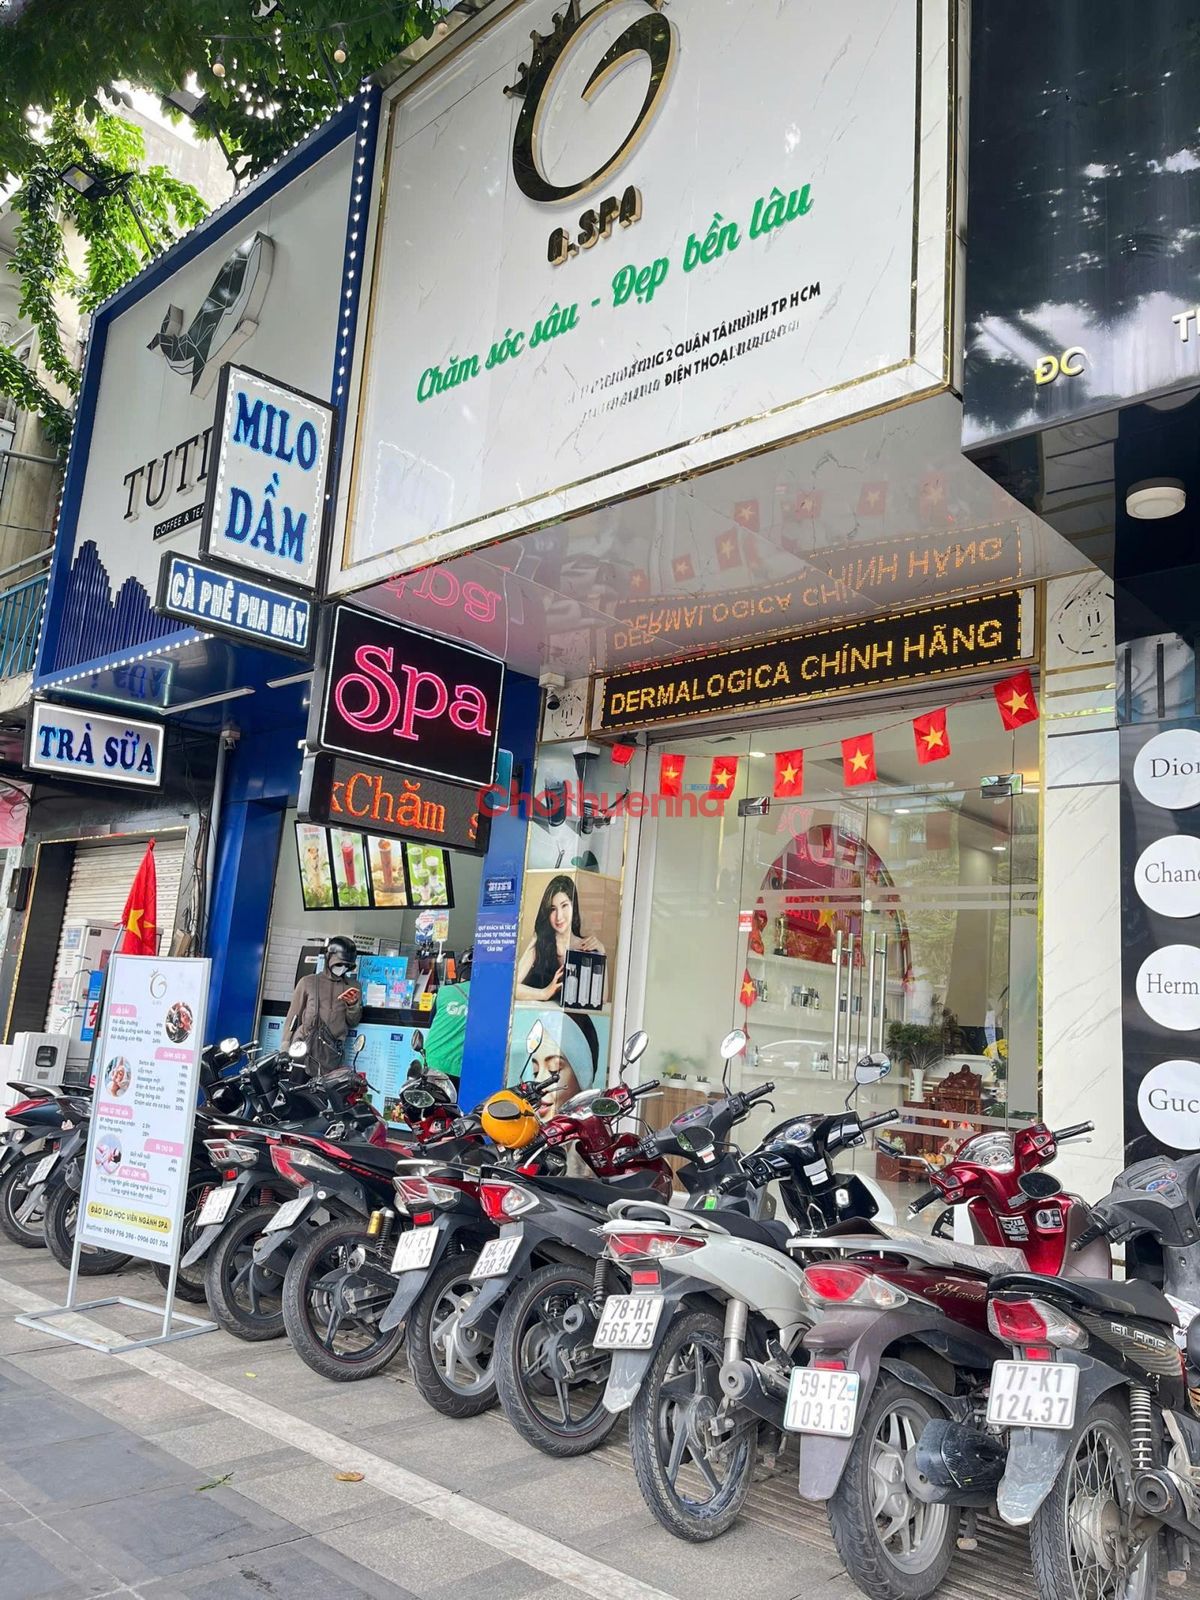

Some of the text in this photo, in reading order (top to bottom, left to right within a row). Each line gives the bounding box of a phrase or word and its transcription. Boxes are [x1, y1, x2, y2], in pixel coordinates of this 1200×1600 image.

[416, 354, 480, 403] Chăm
[485, 327, 525, 370] sóc
[529, 303, 580, 349] sâu
[611, 256, 669, 307] Đẹp
[682, 211, 741, 273] bền
[749, 183, 815, 240] lâu
[675, 331, 710, 358] QUẬN
[664, 364, 692, 387] ĐIỆN
[233, 391, 317, 471] MILO
[155, 516, 182, 537] COFFEE
[183, 512, 189, 523] &
[225, 472, 307, 564] DẦM
[171, 567, 195, 610] CÀ
[199, 580, 235, 621] PHÊ
[236, 592, 269, 632] PHA
[610, 619, 1002, 716] DERMALOGICA CHÍNH HÃNG
[335, 644, 492, 741] Spa
[39, 722, 155, 774] TRÀ SỮA
[1145, 861, 1200, 884] Chan
[611, 1299, 653, 1321] 78-H1
[598, 1322, 654, 1344] 565.75
[799, 1371, 848, 1400] 59-F2
[1006, 1365, 1063, 1393] 77-K1
[995, 1392, 1070, 1424] 124.37
